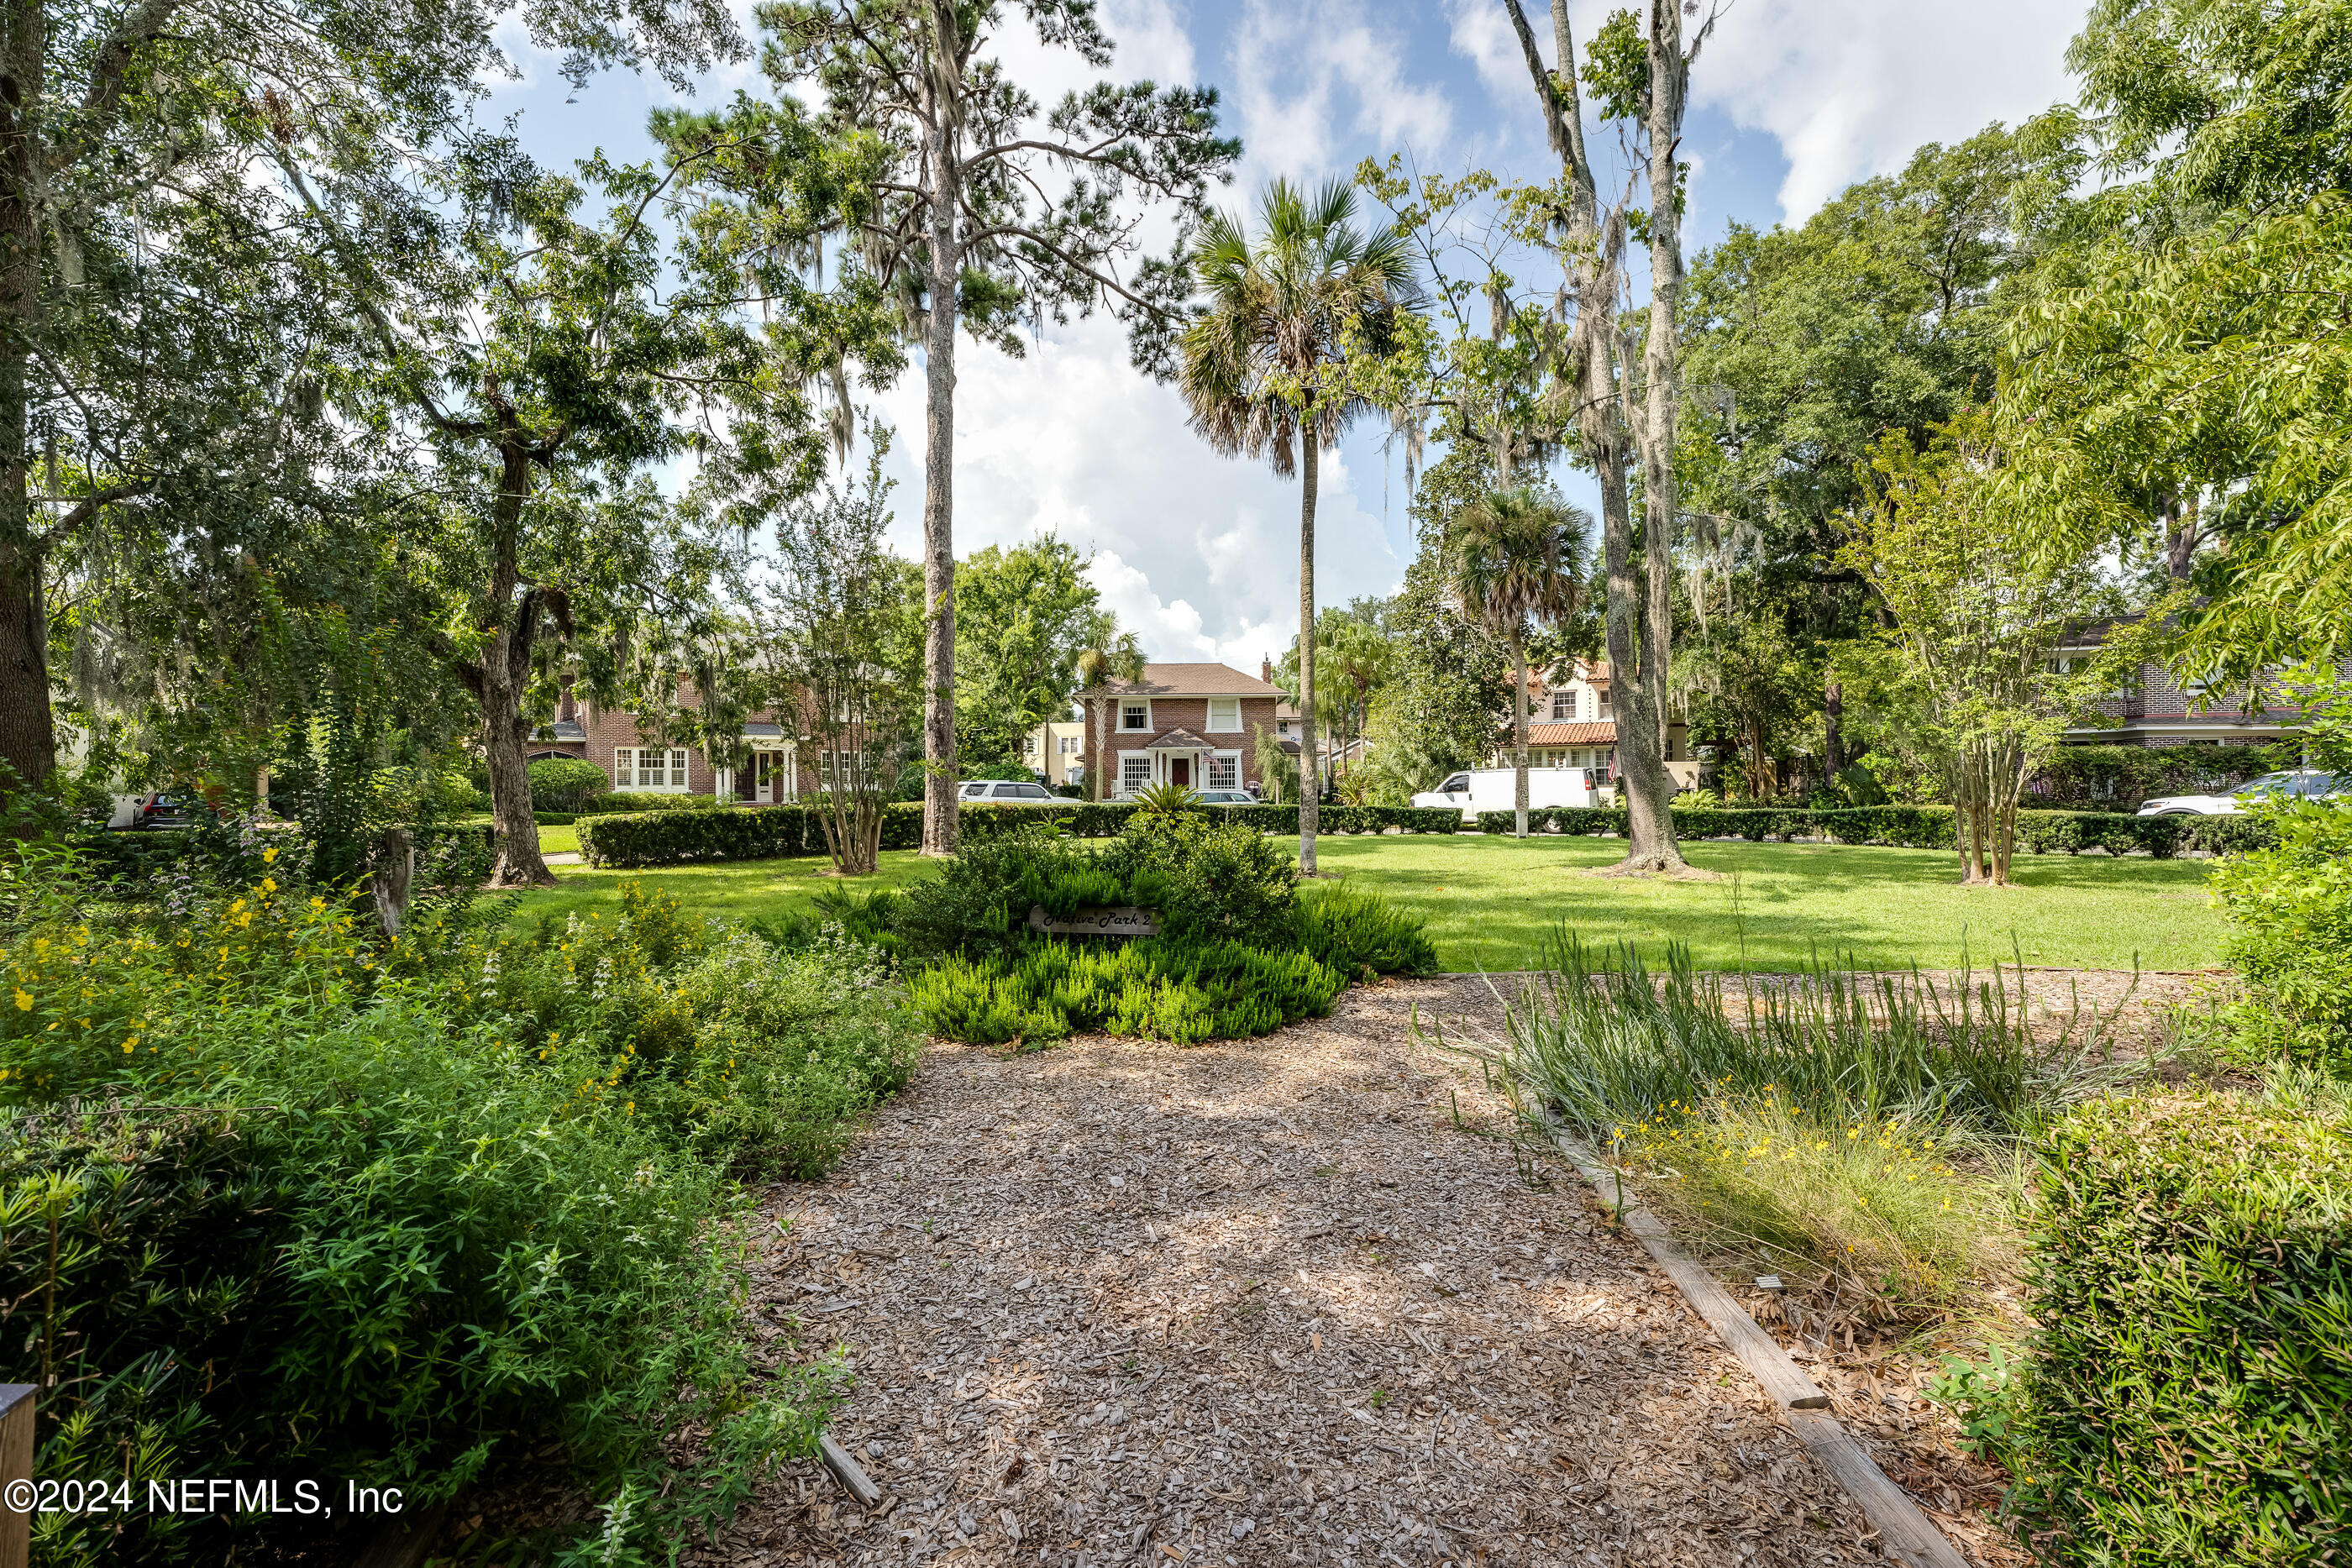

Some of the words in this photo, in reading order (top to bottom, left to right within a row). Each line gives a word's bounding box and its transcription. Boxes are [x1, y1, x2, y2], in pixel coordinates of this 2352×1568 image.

[1043, 913, 1095, 926] Native
[1099, 912, 1137, 928] Park
[1142, 914, 1152, 926] 2
